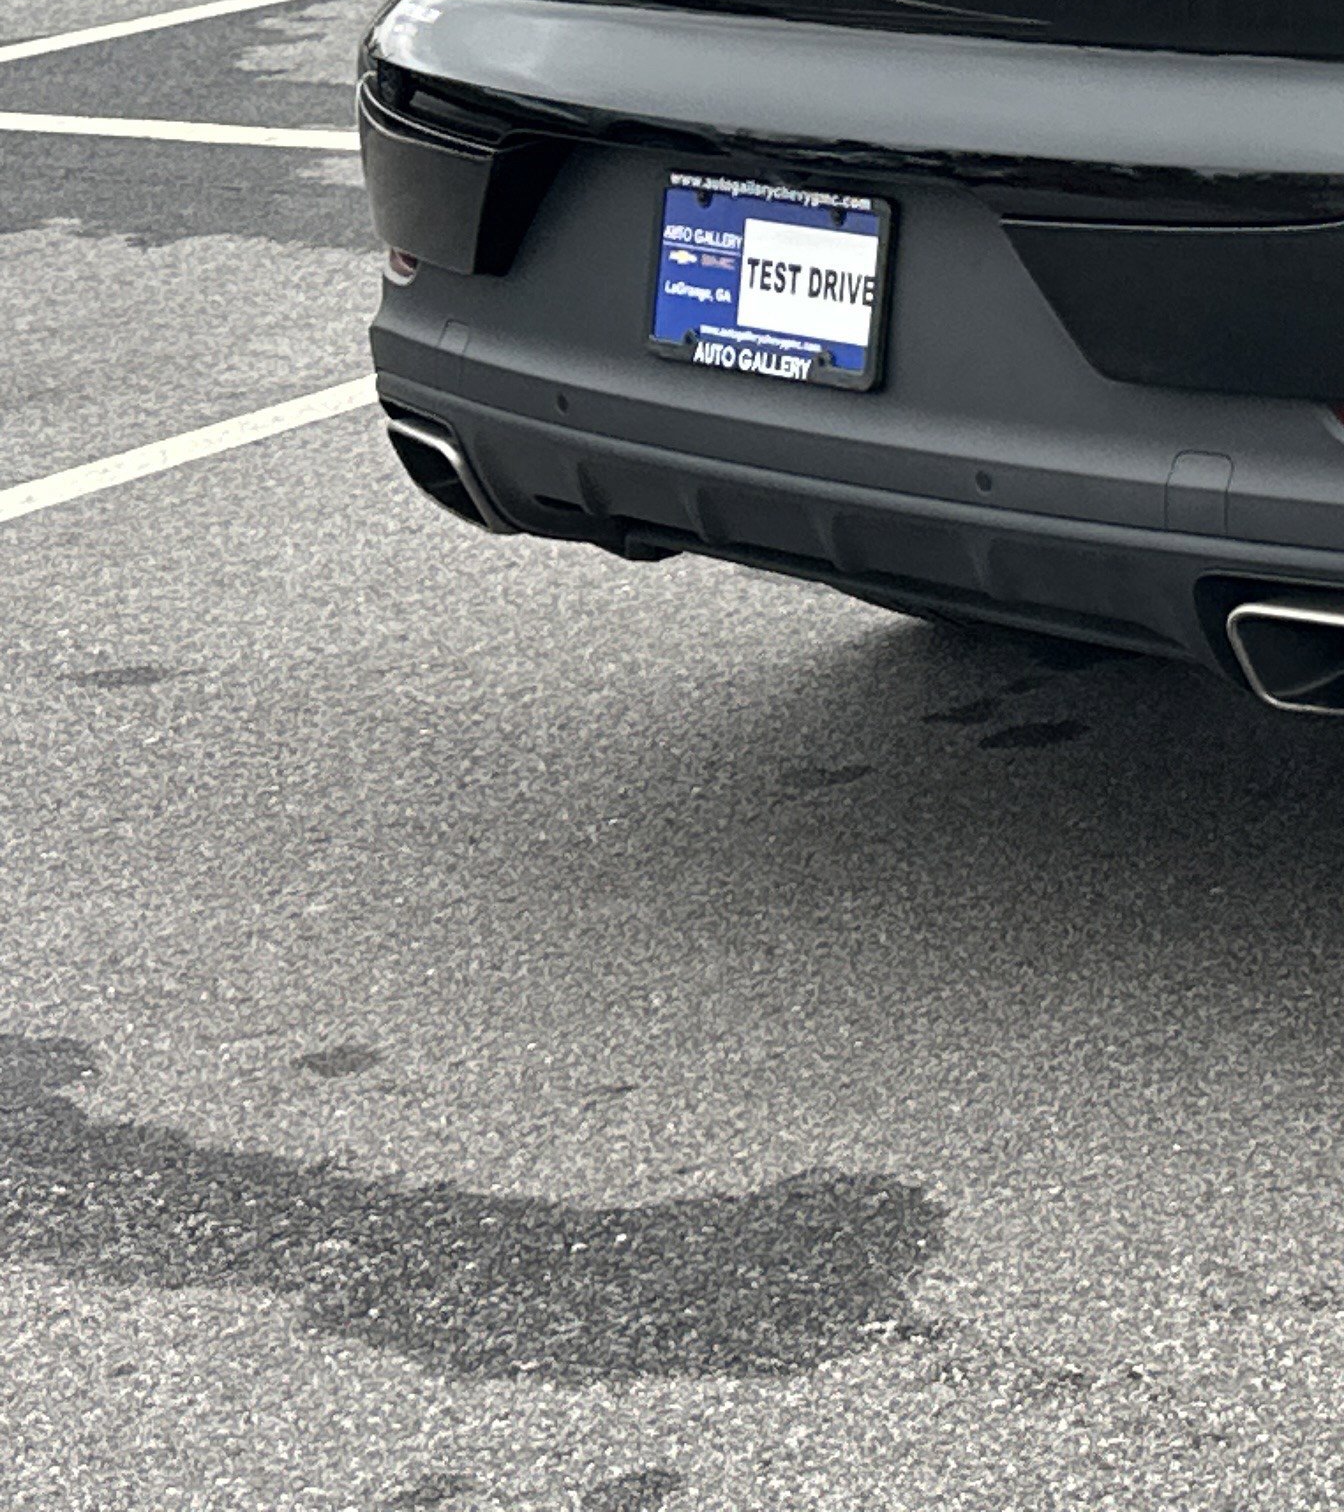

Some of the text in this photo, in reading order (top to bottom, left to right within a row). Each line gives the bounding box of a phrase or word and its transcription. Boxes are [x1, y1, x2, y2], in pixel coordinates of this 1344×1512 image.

[663, 225, 742, 249] AUTO GALLERY
[747, 257, 802, 295] TEST
[808, 266, 875, 307] DRIVE
[693, 341, 812, 381] AUTO GALLERY
